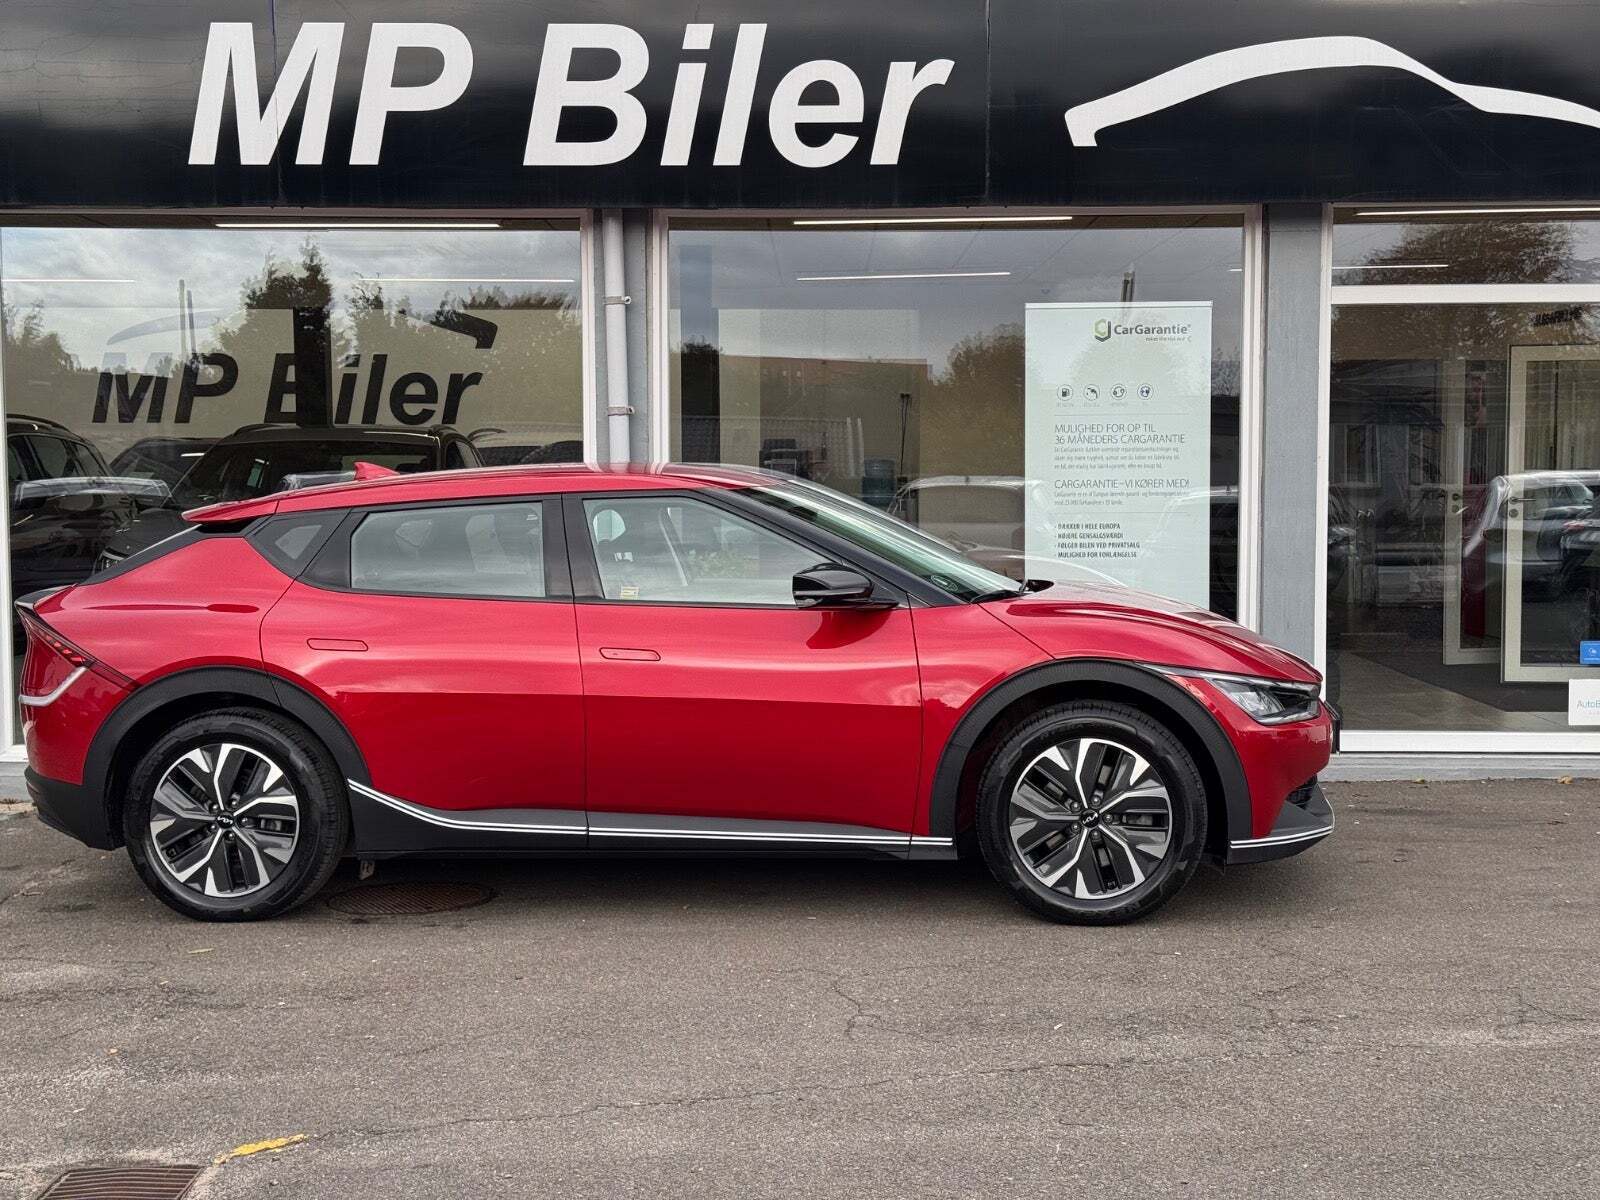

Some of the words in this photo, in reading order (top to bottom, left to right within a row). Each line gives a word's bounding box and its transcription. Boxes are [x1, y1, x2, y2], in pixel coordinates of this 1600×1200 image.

[188, 22, 474, 166] MP
[523, 23, 955, 168] Biler
[92, 351, 239, 424] MP
[1055, 434, 1065, 444] 36
[1120, 434, 1186, 444] CARGARANTIE
[1106, 423, 1125, 433] FOR
[1127, 423, 1142, 433] OP
[1144, 423, 1157, 433] TIL
